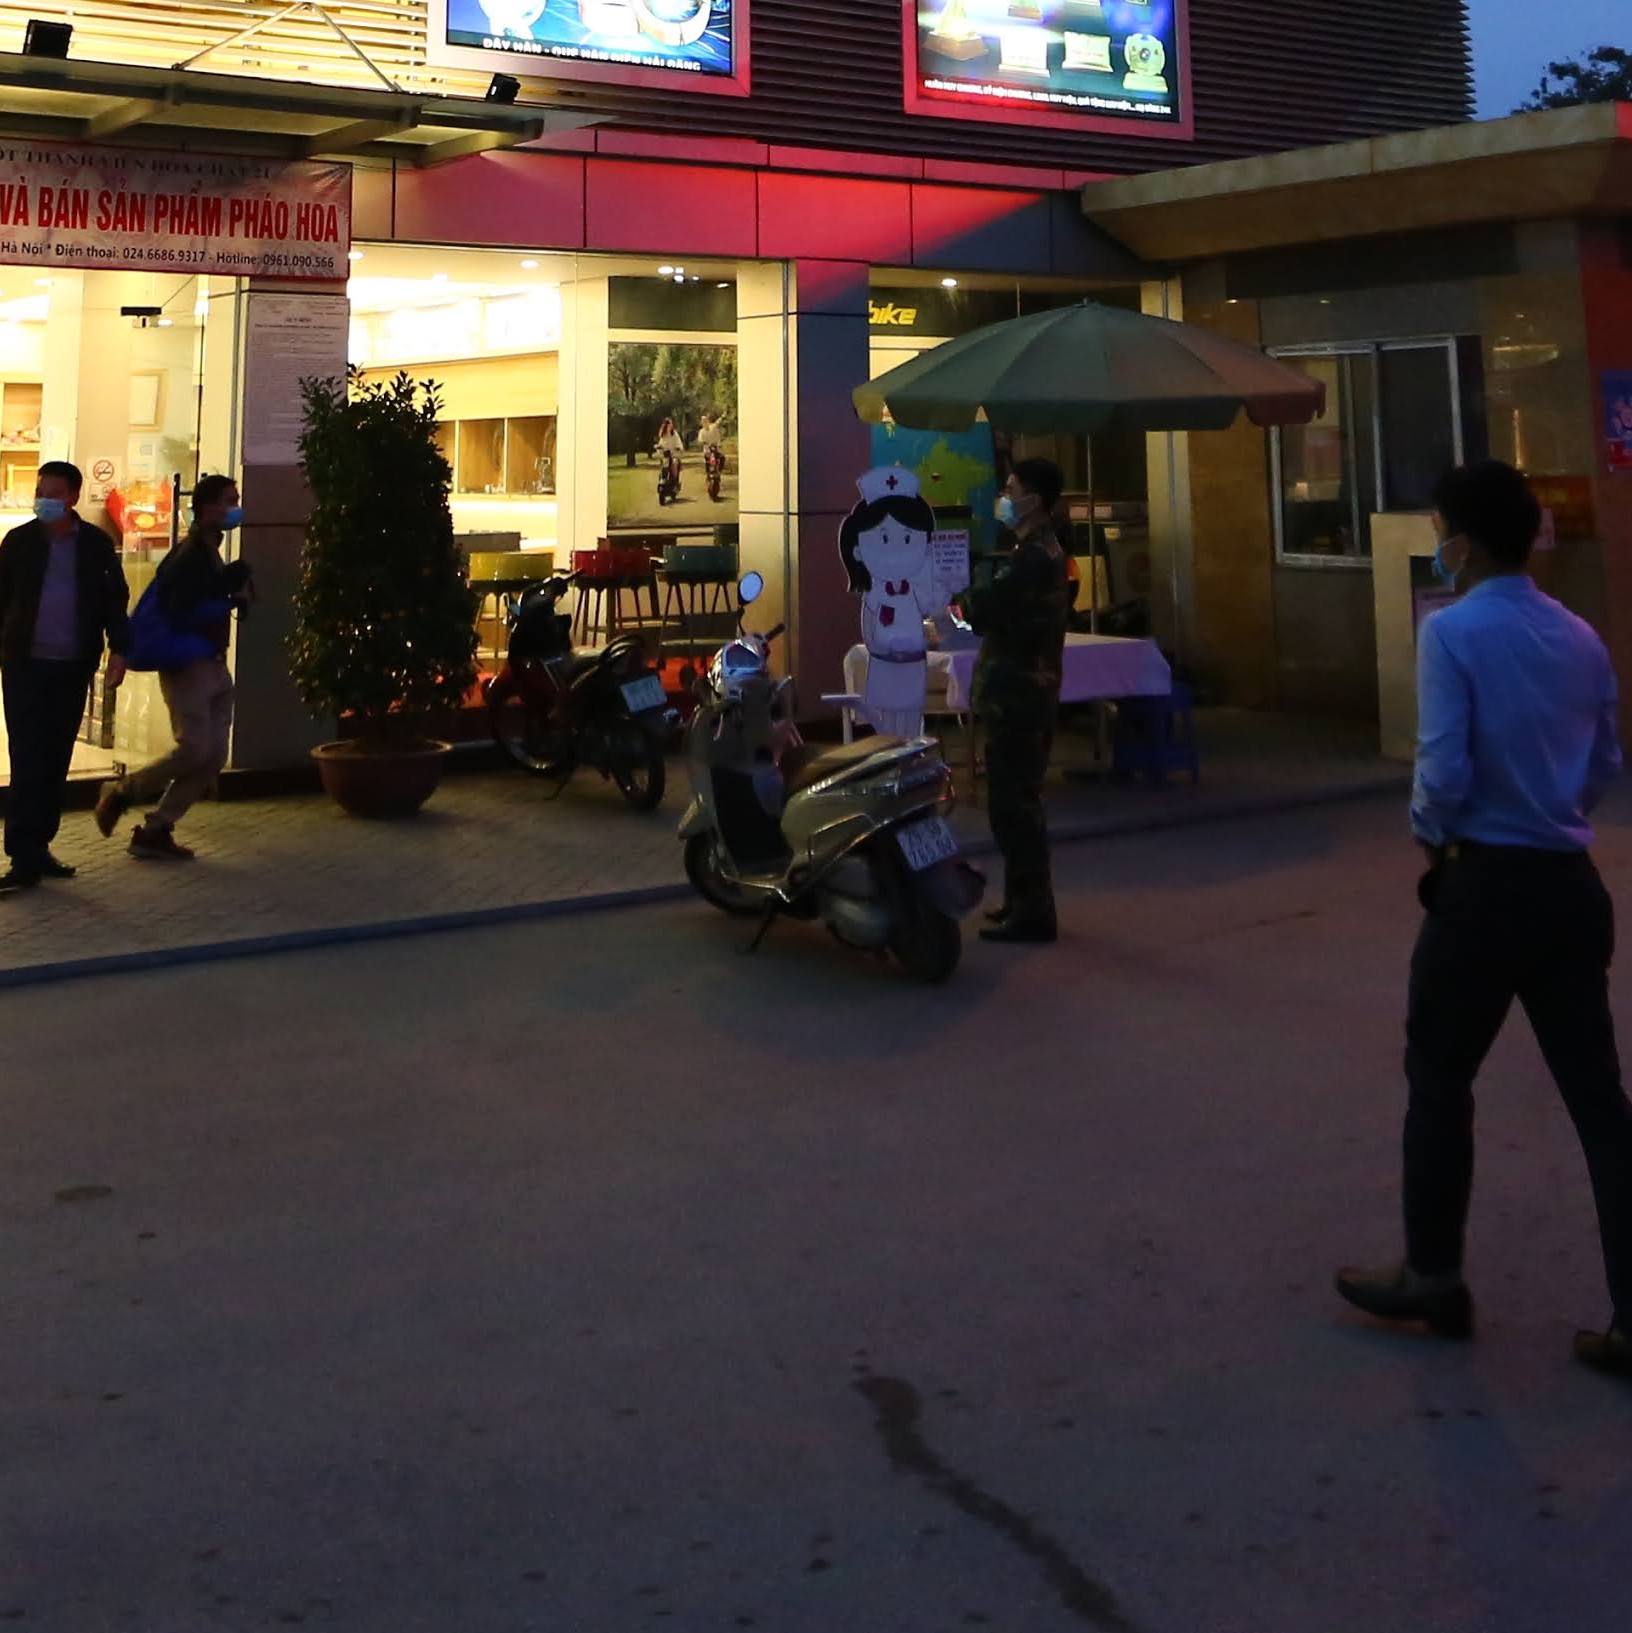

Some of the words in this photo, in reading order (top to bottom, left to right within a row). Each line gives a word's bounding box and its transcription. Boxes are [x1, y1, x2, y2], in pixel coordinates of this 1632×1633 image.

[37, 176, 90, 230] BÁN
[96, 176, 147, 234] SẢN
[153, 179, 224, 238] PHẨM
[228, 192, 290, 241] PHÁO
[296, 202, 339, 244] HOA
[1, 240, 18, 255] Hà
